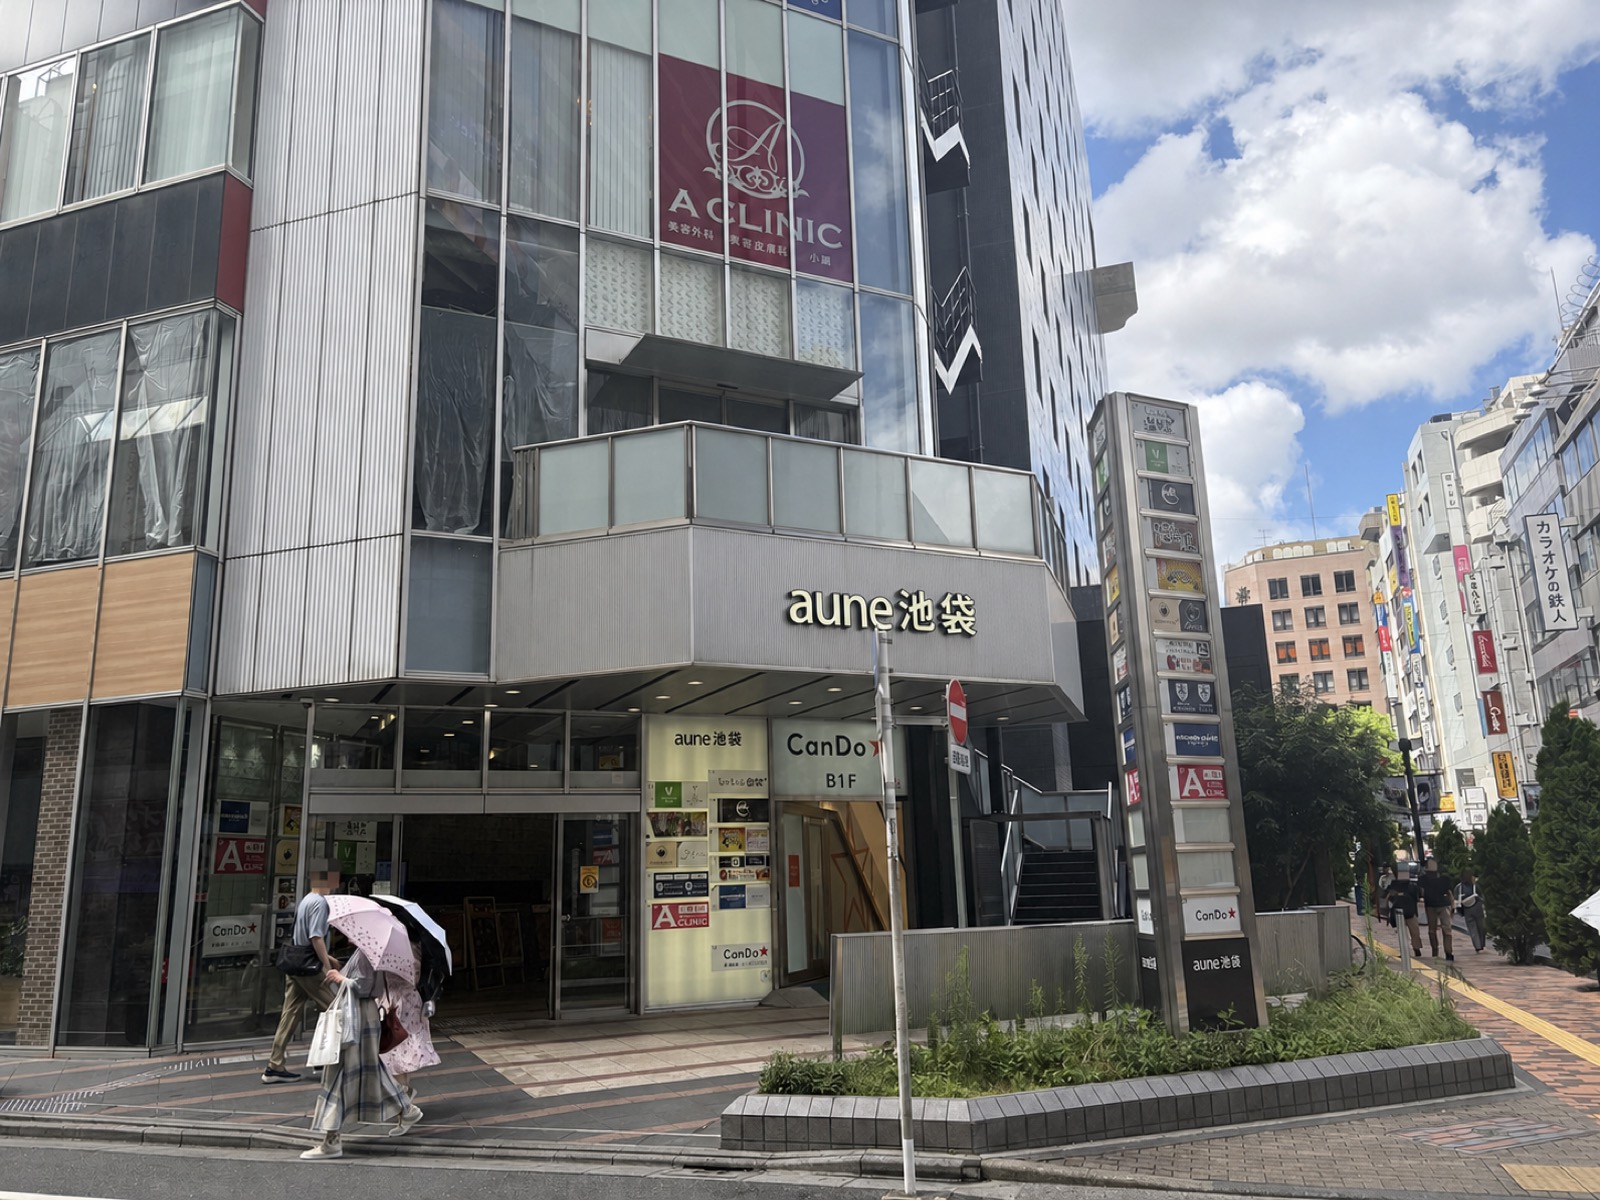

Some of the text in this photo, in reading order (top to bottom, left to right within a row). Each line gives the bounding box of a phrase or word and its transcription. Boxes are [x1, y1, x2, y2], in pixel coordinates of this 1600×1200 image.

[668, 187, 843, 250] A CLINIC
[667, 220, 715, 242] 美容外科
[1536, 520, 1567, 624] カラオケの鉄人
[788, 588, 978, 637] aune池袋
[674, 731, 743, 747] aune池袋
[787, 732, 867, 758] CanDo
[826, 773, 857, 789] B1F
[1181, 768, 1207, 797] A
[653, 904, 678, 929] A
[1195, 909, 1228, 921] CanDo
[212, 924, 247, 937] CanDo
[723, 947, 759, 960] CanDo
